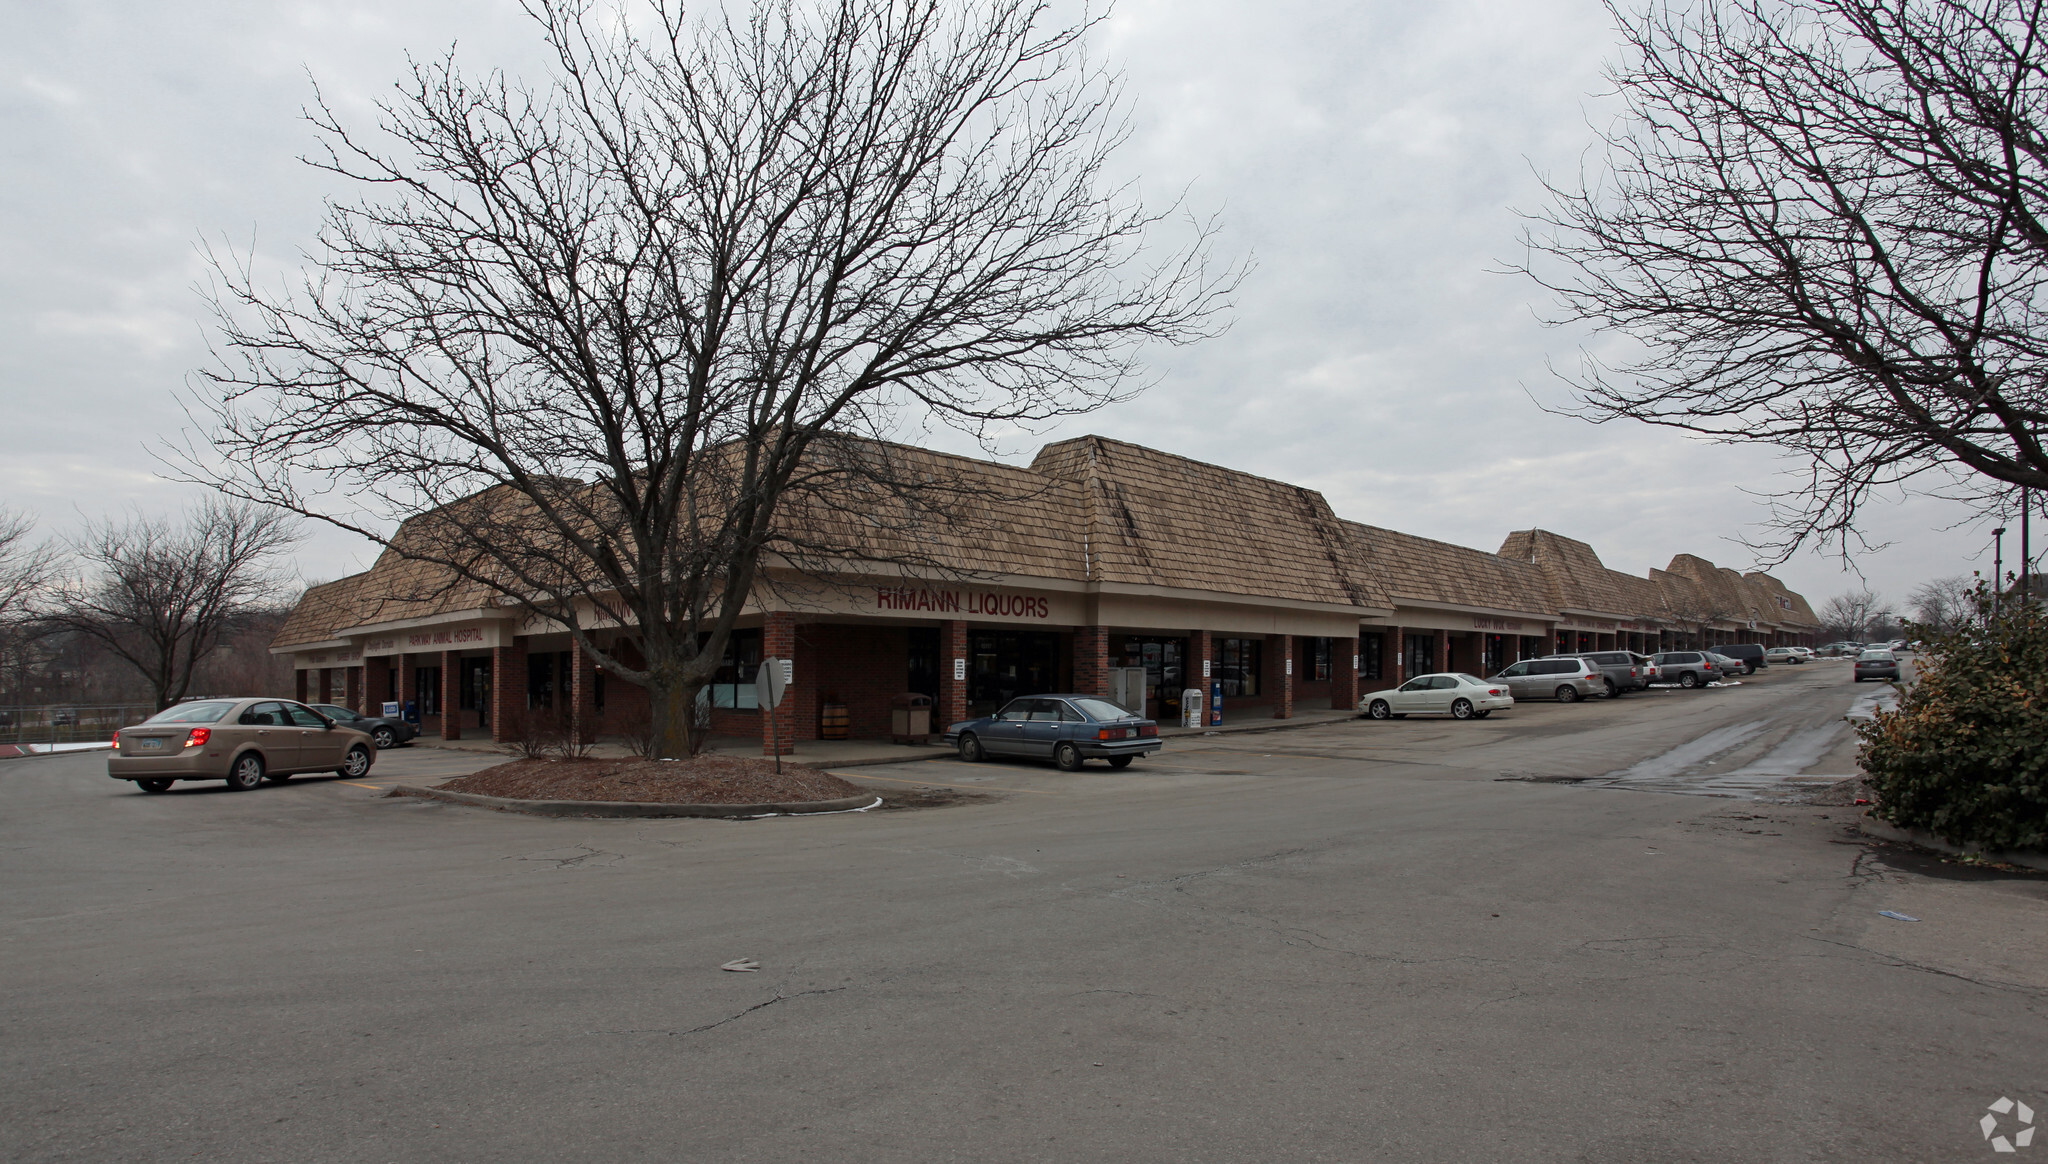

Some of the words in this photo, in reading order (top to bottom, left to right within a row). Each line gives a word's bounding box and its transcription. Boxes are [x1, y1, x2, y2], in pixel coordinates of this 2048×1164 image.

[877, 586, 959, 613] RIMANN
[968, 592, 1049, 619] LIQUORS
[409, 632, 431, 647] PARKWAY
[433, 631, 452, 645] ANIMAL
[454, 627, 483, 643] HOSPITAL
